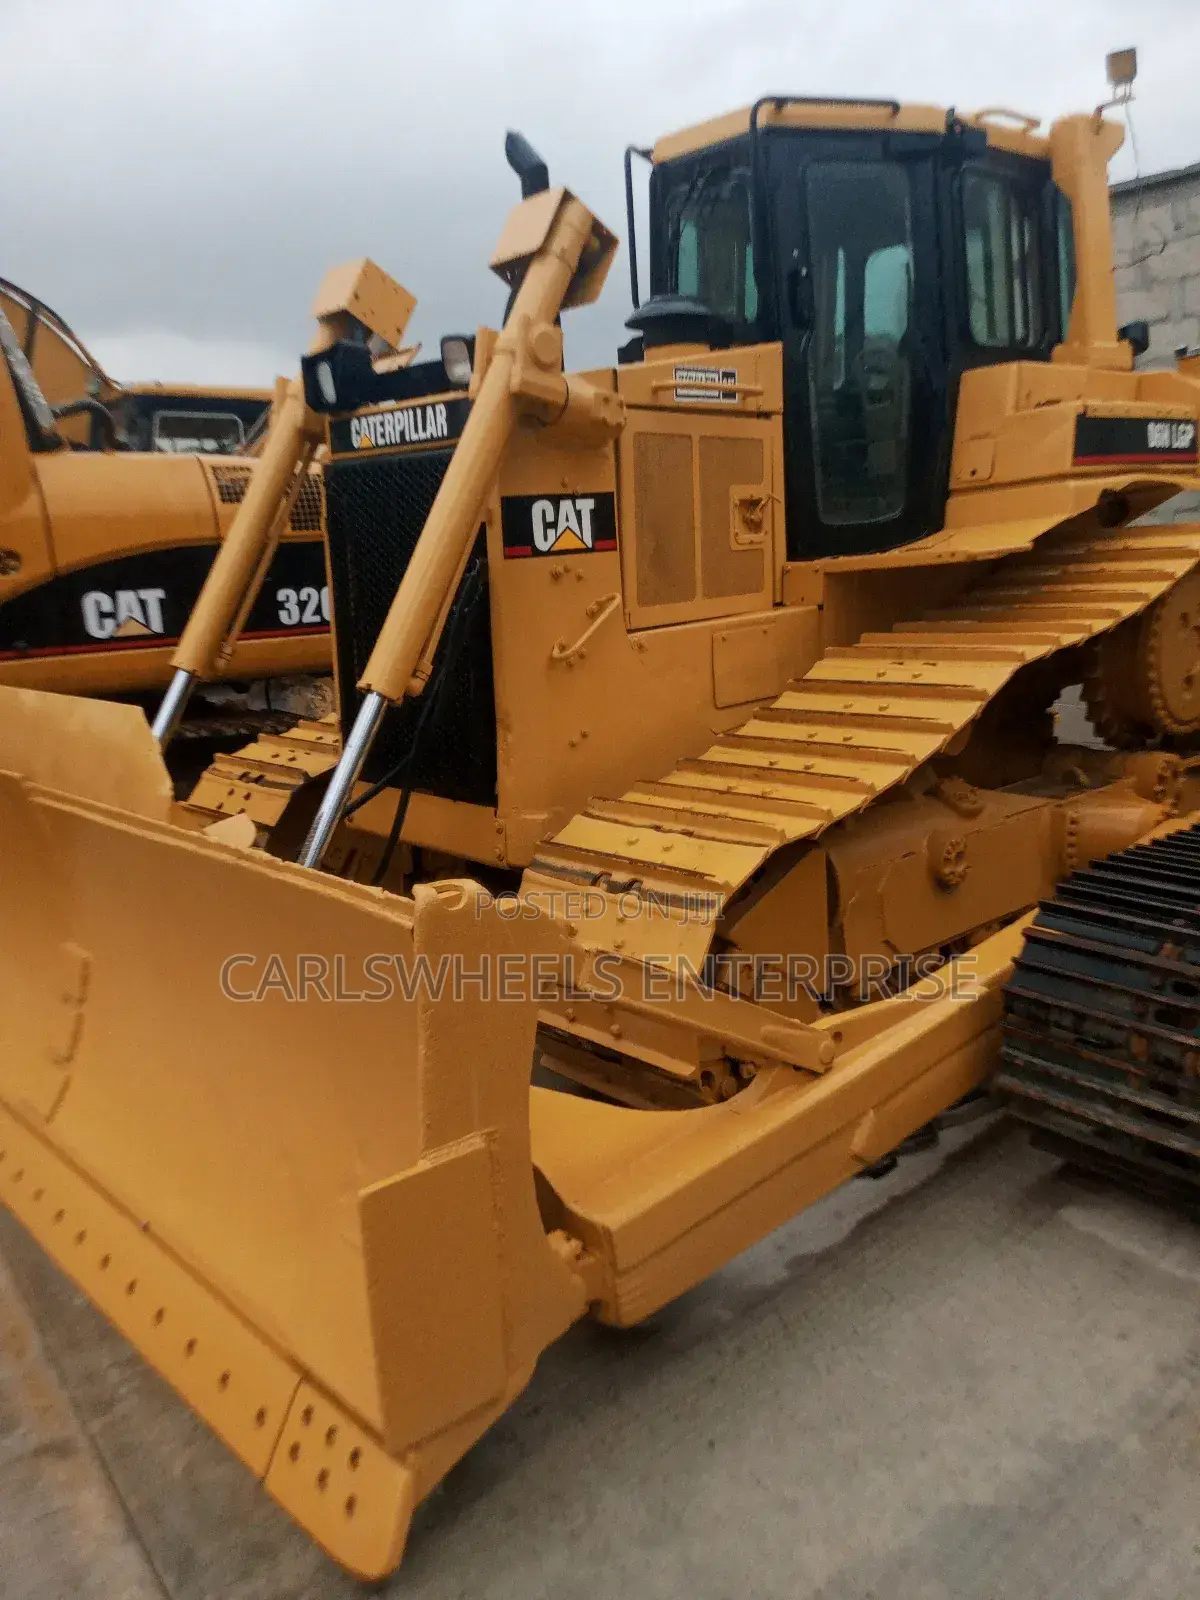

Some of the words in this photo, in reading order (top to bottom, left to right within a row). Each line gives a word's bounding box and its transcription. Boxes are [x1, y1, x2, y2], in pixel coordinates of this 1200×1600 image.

[350, 402, 447, 449] CATERPILLAR
[531, 498, 595, 552] CAT
[81, 588, 167, 639] CAT
